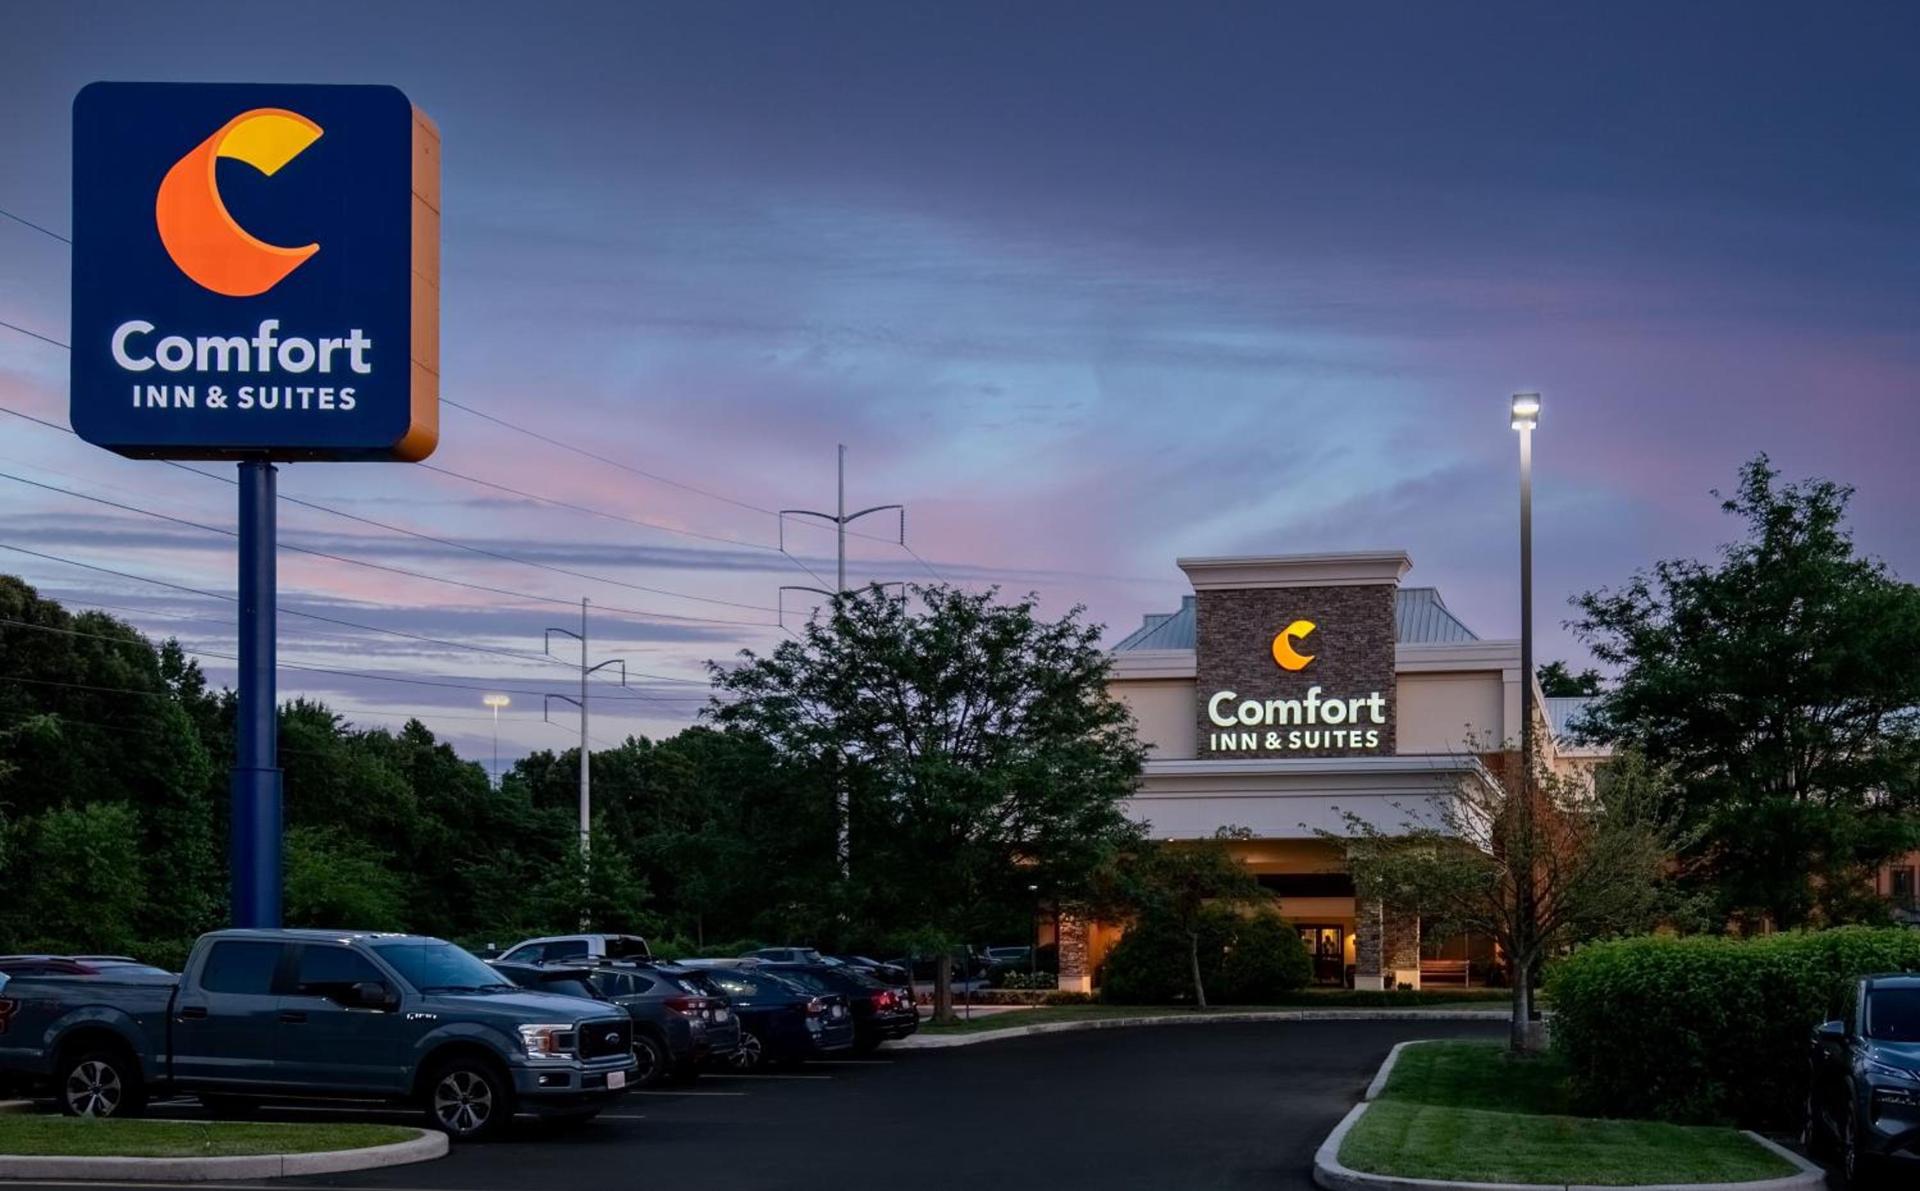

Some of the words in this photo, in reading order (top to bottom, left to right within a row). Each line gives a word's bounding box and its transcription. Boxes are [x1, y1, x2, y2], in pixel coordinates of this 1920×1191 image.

[111, 319, 372, 374] Comfort
[132, 385, 196, 408] INN
[206, 386, 228, 409] &
[238, 386, 356, 411] SUITES
[1208, 686, 1386, 727] Comfort
[1210, 733, 1258, 751] INN
[1264, 731, 1282, 750] &
[1289, 730, 1379, 749] SUITES
